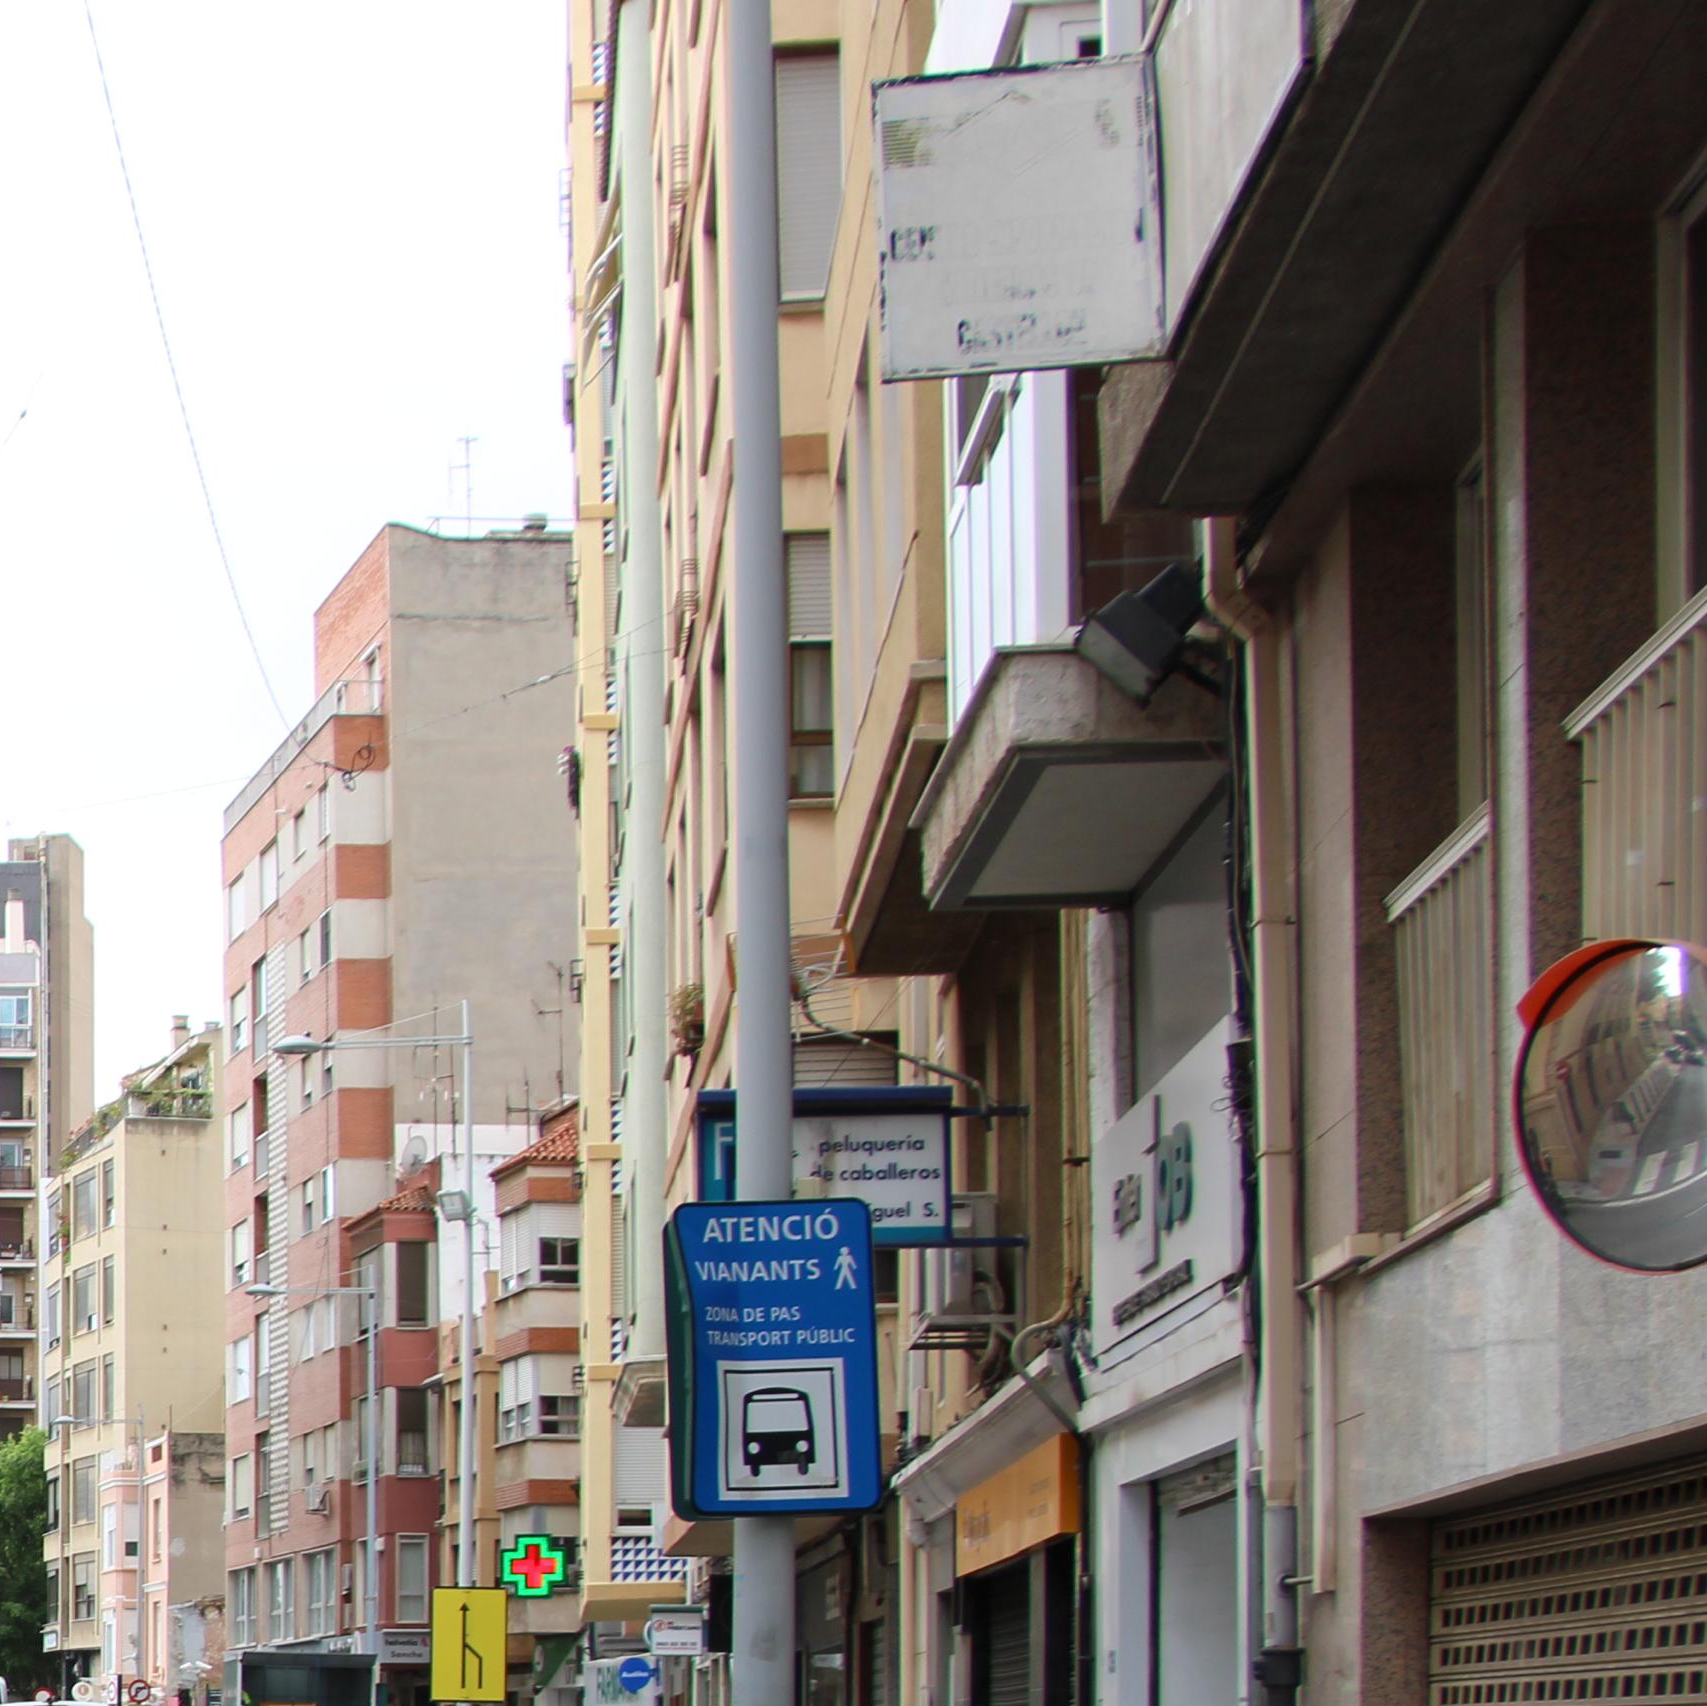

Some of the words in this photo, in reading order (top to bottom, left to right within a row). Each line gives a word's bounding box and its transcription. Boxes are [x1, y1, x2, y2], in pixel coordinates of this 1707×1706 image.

[818, 1134, 926, 1156] peluquería
[839, 1162, 941, 1181] caballeros
[922, 1201, 939, 1218] S.
[702, 1207, 839, 1243] ATENCIÓ
[695, 1258, 822, 1283] VIANANTS
[704, 1306, 740, 1322] ZONA
[742, 1306, 765, 1322] DE
[770, 1305, 801, 1321] PAS
[707, 1330, 792, 1347] TRANSPORT
[796, 1326, 856, 1344] PÚBLIC
